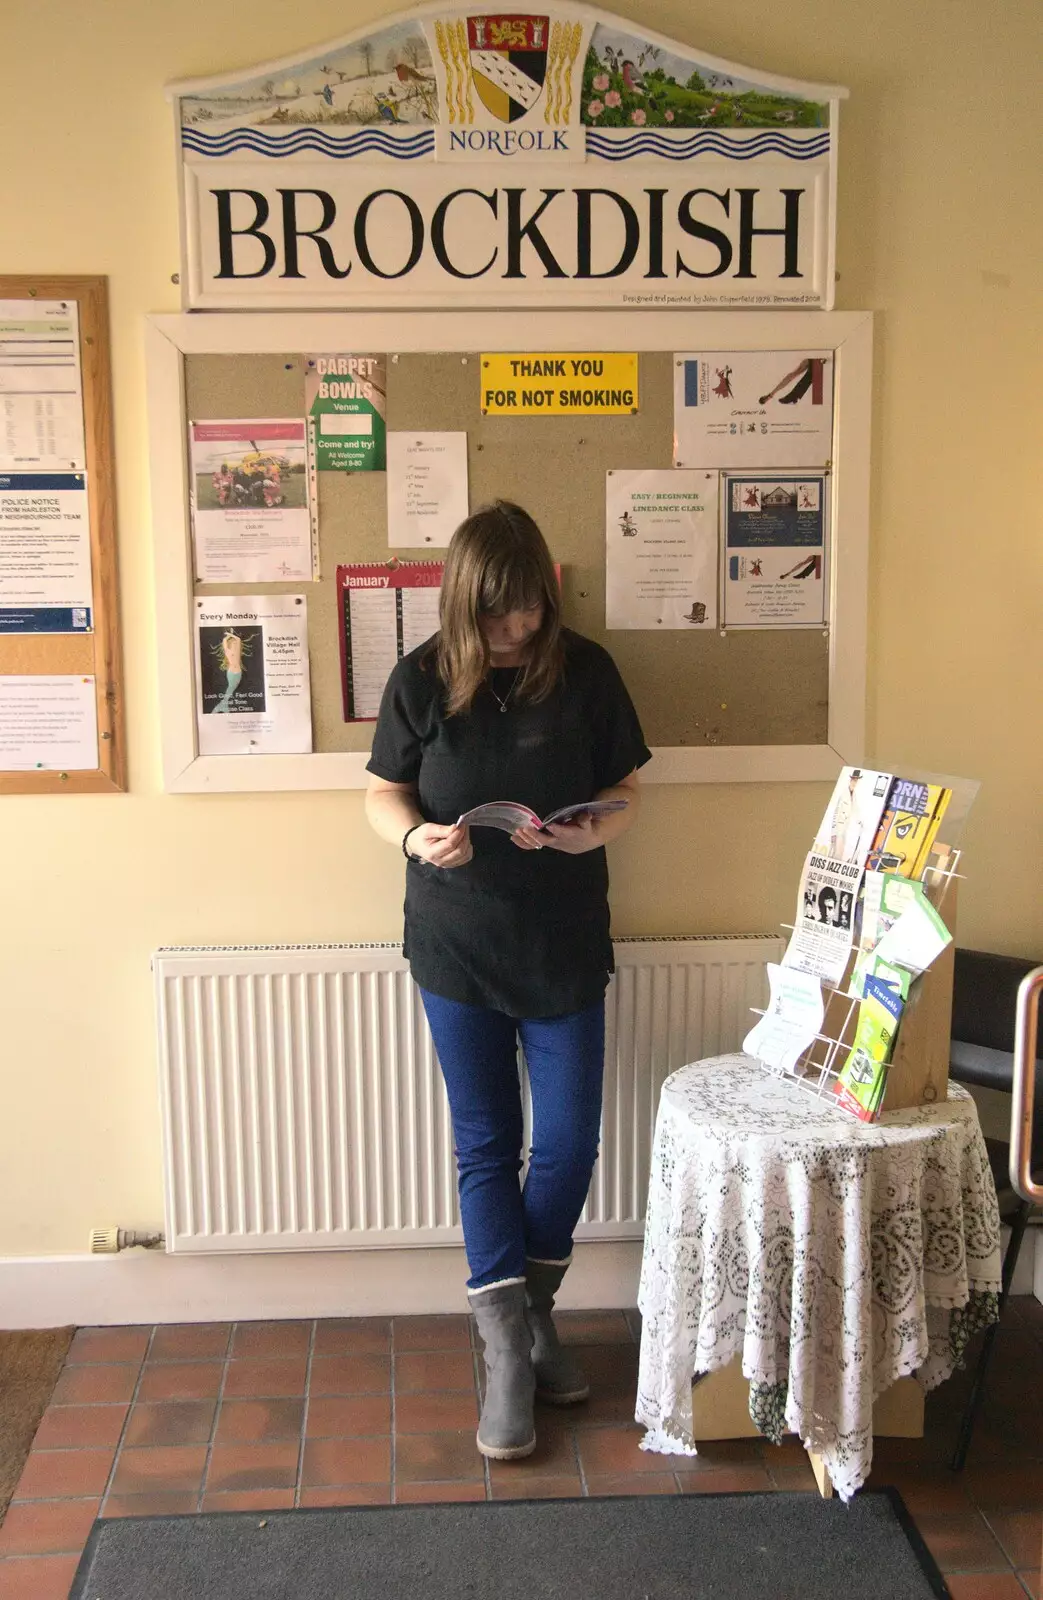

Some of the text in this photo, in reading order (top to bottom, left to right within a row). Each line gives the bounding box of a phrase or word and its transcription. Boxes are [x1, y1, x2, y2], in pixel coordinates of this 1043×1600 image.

[449, 130, 570, 156] NORFOLK
[210, 187, 806, 280] BROCKDISH
[623, 294, 653, 304] Designed
[667, 295, 691, 304] painted
[316, 358, 375, 376] CARPET
[511, 360, 604, 377] THANK YOU
[319, 382, 373, 399] BOWLS
[486, 389, 634, 407] FOR NOT SMOKING
[318, 441, 343, 449] Come
[361, 441, 375, 450] try!
[2, 498, 60, 506] POLICE NOTICE
[631, 493, 652, 501] EASY
[656, 493, 699, 501] BEGINNER
[633, 505, 680, 513] LINEDANCE
[343, 575, 390, 588] January
[200, 613, 224, 622] Every
[226, 612, 258, 621] Monday
[810, 856, 860, 879] DISS JAZZ CLUB
[873, 985, 898, 1013] Timetable
